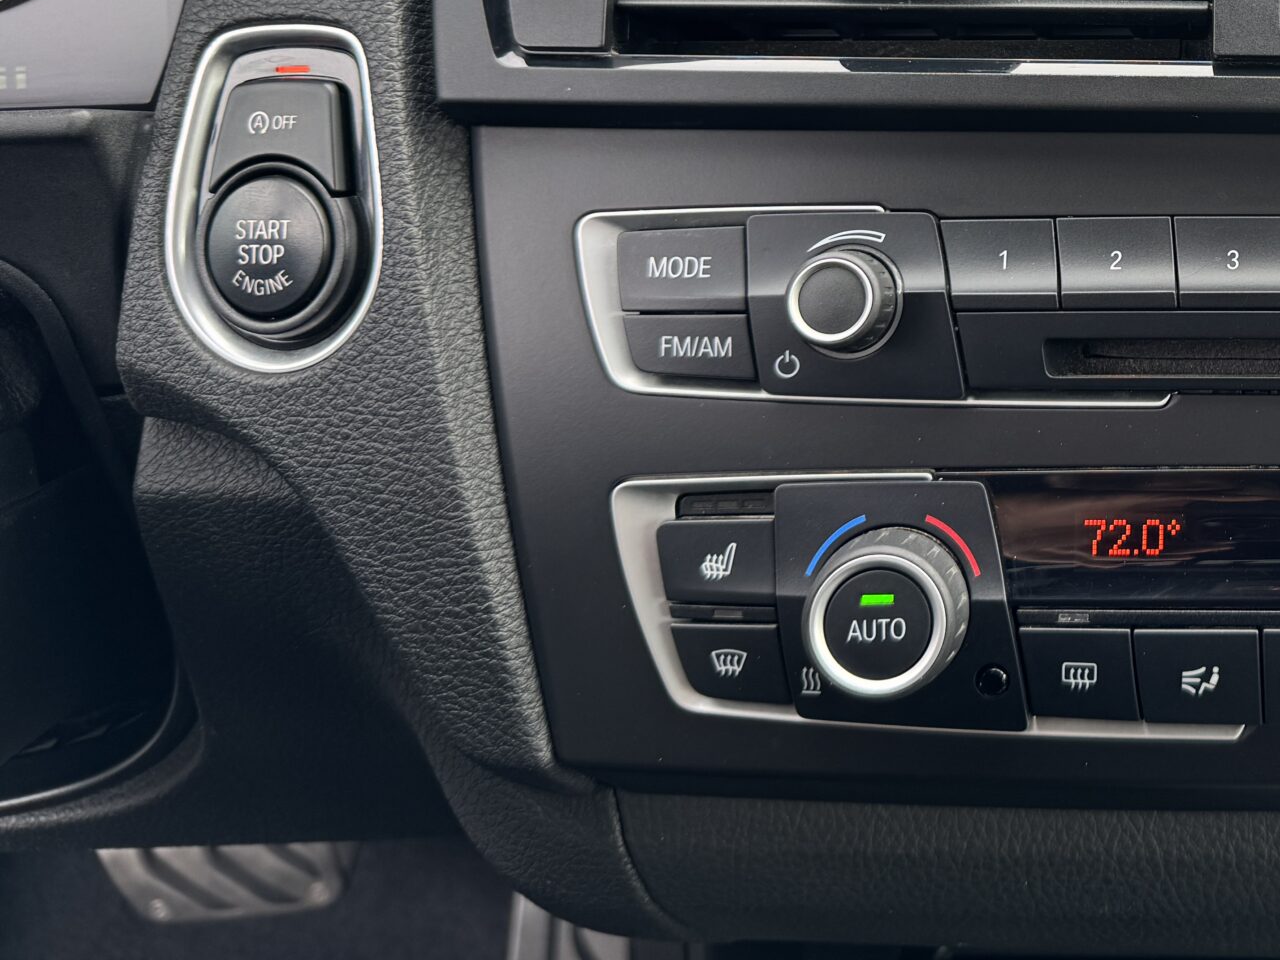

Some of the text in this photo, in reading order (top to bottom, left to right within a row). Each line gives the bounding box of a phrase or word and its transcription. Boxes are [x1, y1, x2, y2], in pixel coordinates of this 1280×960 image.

[272, 115, 298, 130] OFF
[235, 219, 291, 240] START
[237, 244, 285, 265] STOP
[999, 251, 1009, 270] 1
[1109, 250, 1122, 271] 2
[1226, 250, 1240, 271] 3
[647, 255, 712, 280] MODE
[232, 269, 294, 296] ENGINE
[660, 335, 733, 360] FM/AM
[847, 618, 907, 642] AUTO
